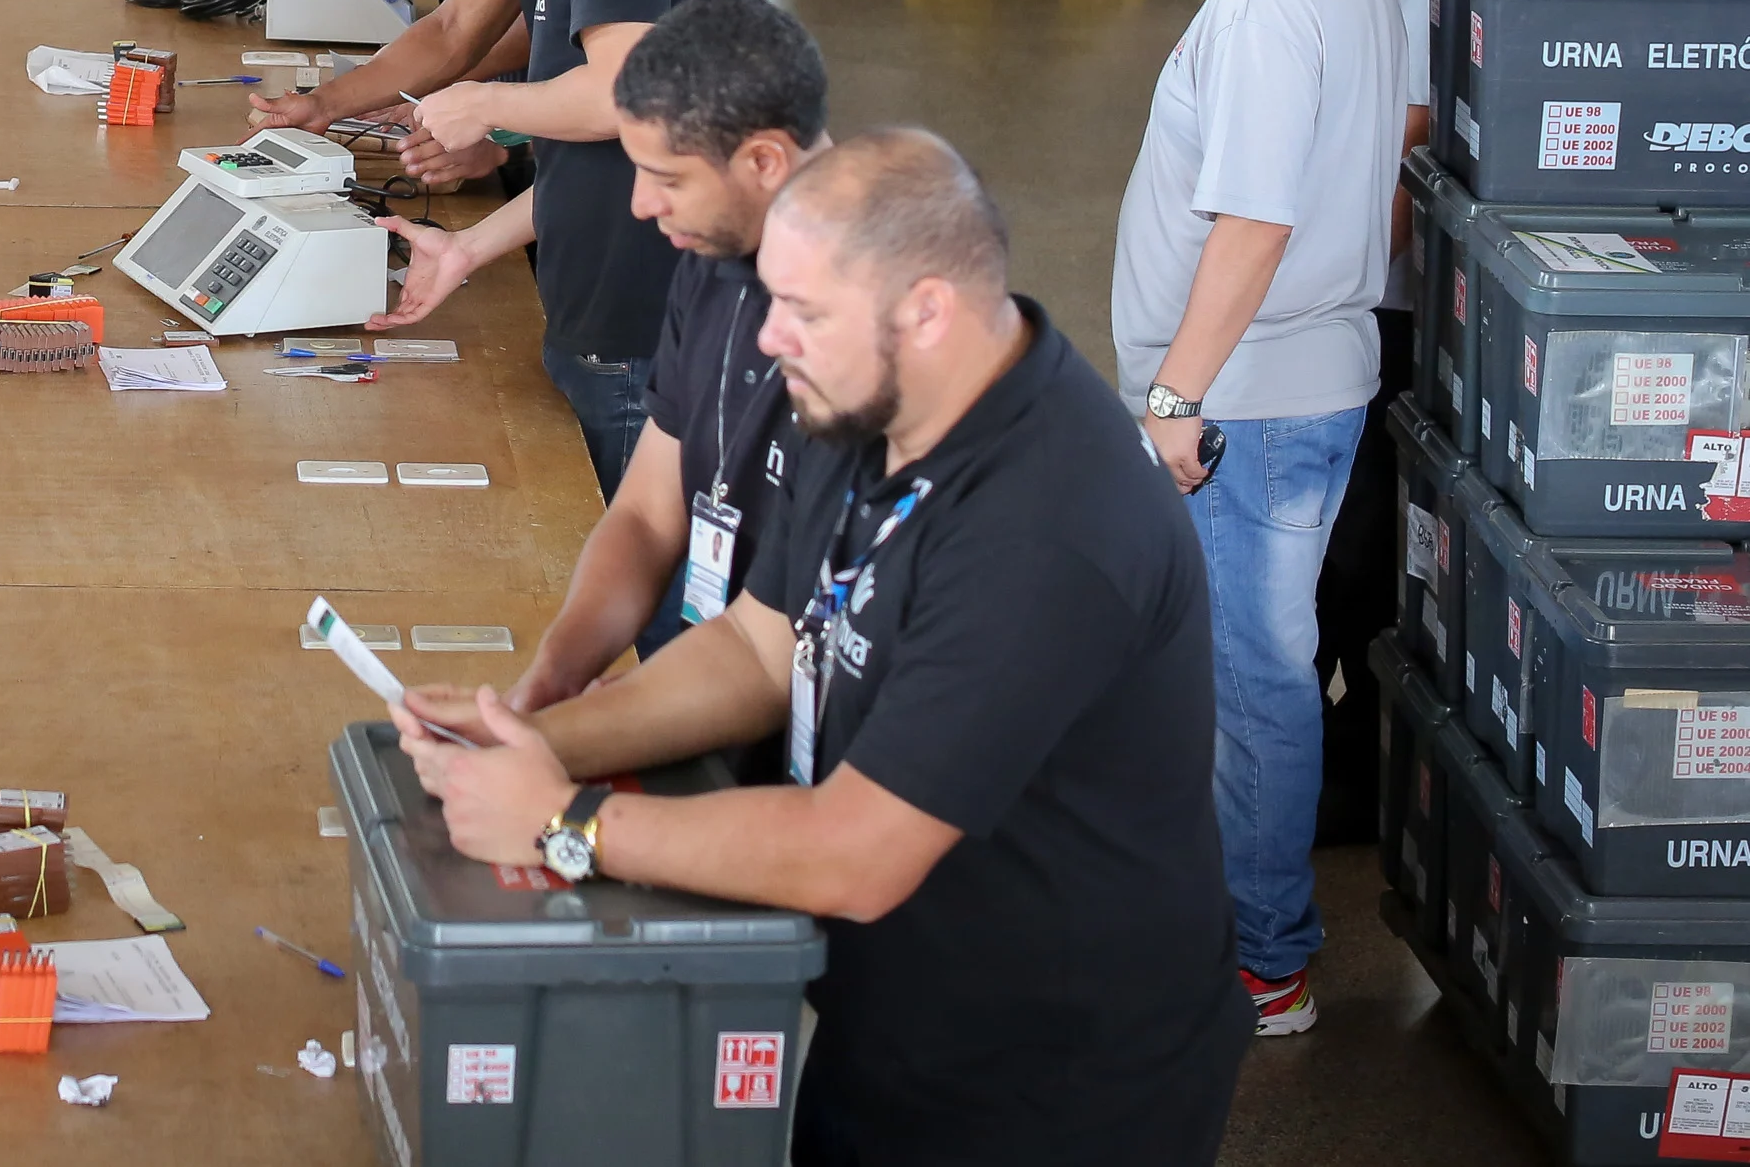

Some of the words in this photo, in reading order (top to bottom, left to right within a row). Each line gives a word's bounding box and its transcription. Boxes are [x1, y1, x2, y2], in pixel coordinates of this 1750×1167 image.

[1542, 41, 1623, 68] URNA
[1565, 107, 1583, 117] UE
[1586, 107, 1601, 117] 98
[1564, 124, 1581, 134] UE
[1585, 124, 1615, 135] 2000
[1562, 140, 1579, 151] UE
[1583, 140, 1614, 151] 2002
[1562, 156, 1579, 166] UE
[1583, 155, 1613, 166] 2004
[1635, 358, 1651, 369] UE
[1656, 358, 1672, 369] 98
[1633, 376, 1651, 387] UE
[1655, 376, 1687, 387] 2000
[1632, 393, 1650, 404] UE
[1654, 393, 1686, 404] 2002
[1632, 410, 1650, 421] UE
[1654, 409, 1686, 421] 2004
[1703, 442, 1731, 451] ALTO
[1604, 484, 1687, 512] URNA
[1651, 583, 1733, 591] CUIDADO
[1699, 711, 1717, 721] UE
[1721, 712, 1737, 722] 98
[1697, 729, 1716, 739] UE
[1696, 746, 1714, 757] UE
[1696, 763, 1714, 774] UE
[1667, 840, 1750, 868] URNA
[1673, 987, 1690, 998] UE
[1695, 986, 1711, 997] 98
[1672, 1005, 1690, 1016] UE
[1694, 1005, 1727, 1016] 2000
[1670, 1022, 1688, 1033] UE
[1692, 1022, 1725, 1033] 2002
[1670, 1038, 1688, 1049] UE
[1692, 1038, 1724, 1049] 2004
[1688, 1081, 1718, 1091] ALTO
